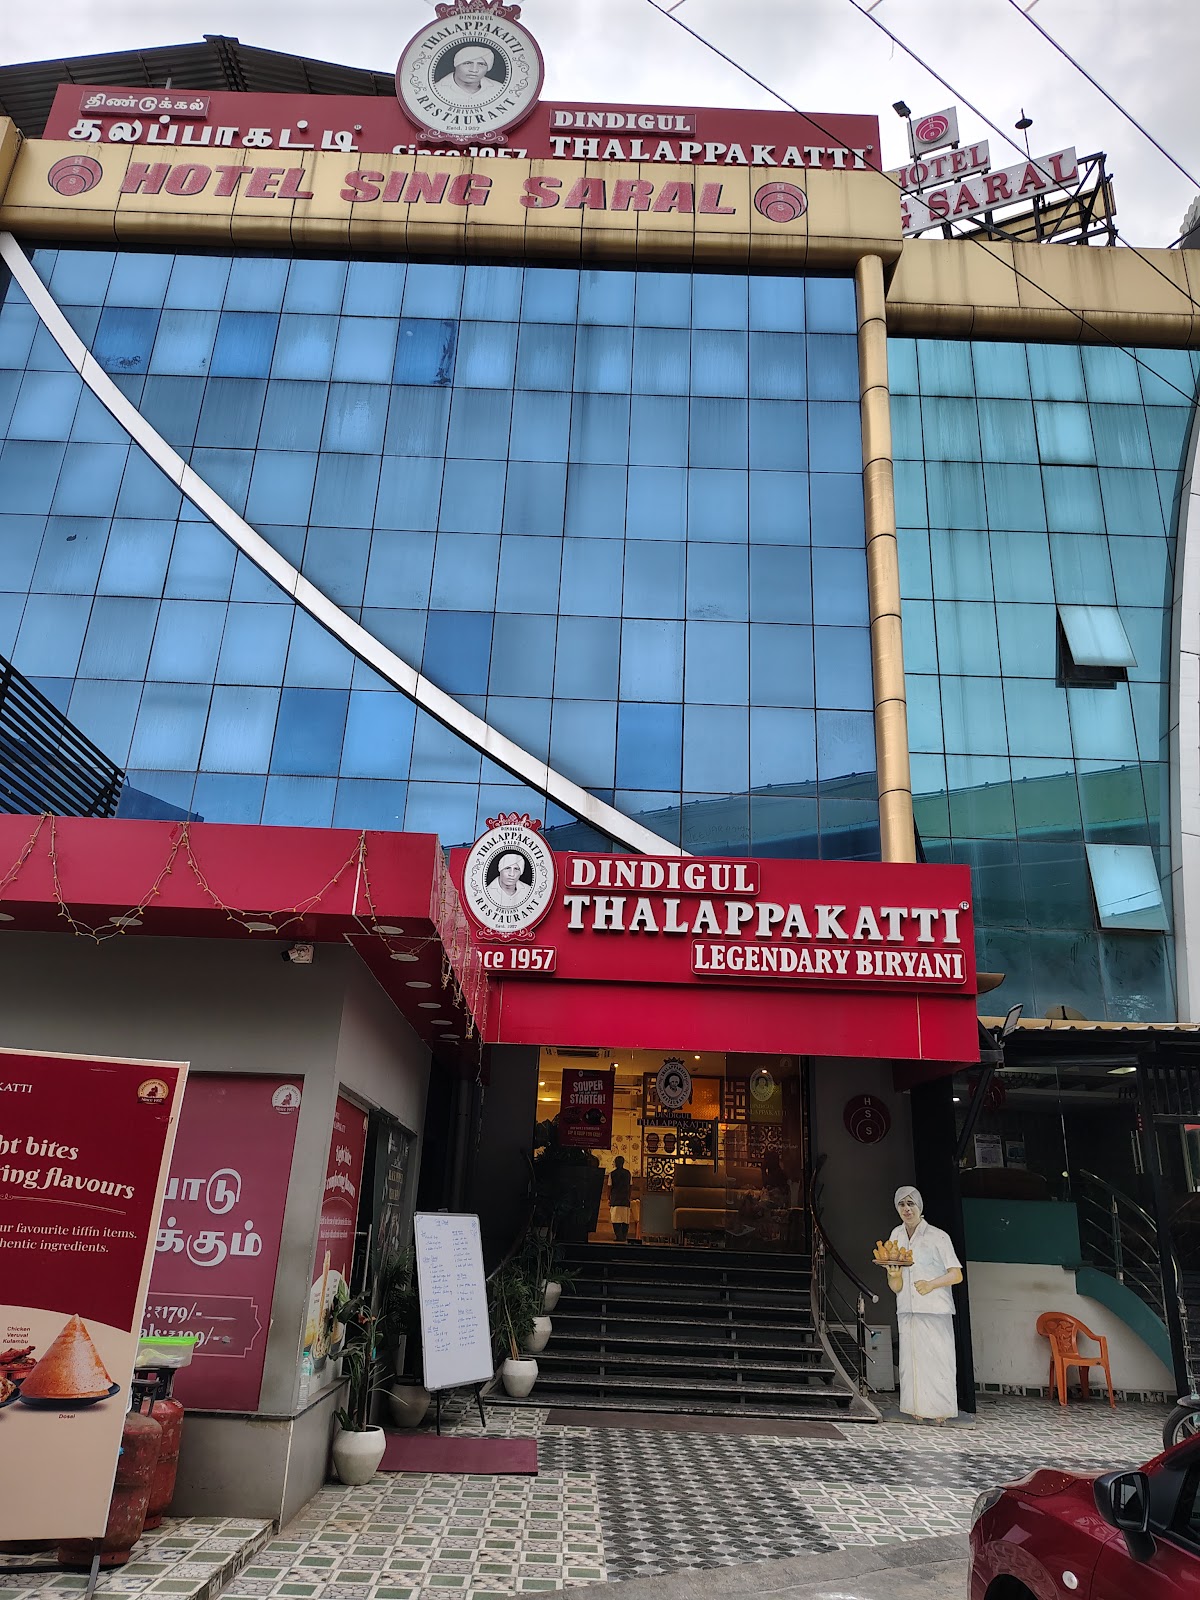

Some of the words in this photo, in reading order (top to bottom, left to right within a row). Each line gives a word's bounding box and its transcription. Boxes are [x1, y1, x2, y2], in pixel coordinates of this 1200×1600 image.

[421, 21, 524, 54] THALAPPAKATTI
[84, 93, 204, 112] திண்டுக்கல்
[417, 98, 515, 125] RESTAURANT
[554, 111, 691, 132] DINDIGUL
[68, 115, 359, 152] தலப்பாகட்டி
[74, 157, 83, 165] H
[550, 136, 866, 169] THALAPPAKATTI
[69, 177, 77, 185] S
[120, 162, 314, 199] HOTEL
[340, 170, 493, 206] SING
[519, 176, 736, 214] SARAL
[776, 183, 785, 191] H
[928, 154, 1078, 221] SARAL
[477, 832, 544, 860] THALAPPAKATTI
[571, 858, 755, 892] DINDIGUL
[475, 898, 540, 924] RESTAURANT
[563, 894, 962, 944] THALAPPAKATTI
[510, 948, 555, 970] 1957
[694, 944, 850, 975] LEGENDARY
[855, 950, 964, 979] BIRYANI
[573, 1080, 604, 1092] SOUPER
[570, 1094, 606, 1105] STARTER!
[864, 1097, 871, 1106] H
[638, 1119, 709, 1129] THALAPPAKATTI
[655, 1112, 691, 1120] DINDIGUL
[864, 1109, 872, 1118] S
[865, 1126, 873, 1135] S
[26, 1136, 79, 1160] bites
[37, 1167, 135, 1199] flavours
[16, 1223, 69, 1236] favourite
[72, 1226, 100, 1237] tiffin
[103, 1226, 137, 1239] items.
[40, 1239, 109, 1253] ingredients.
